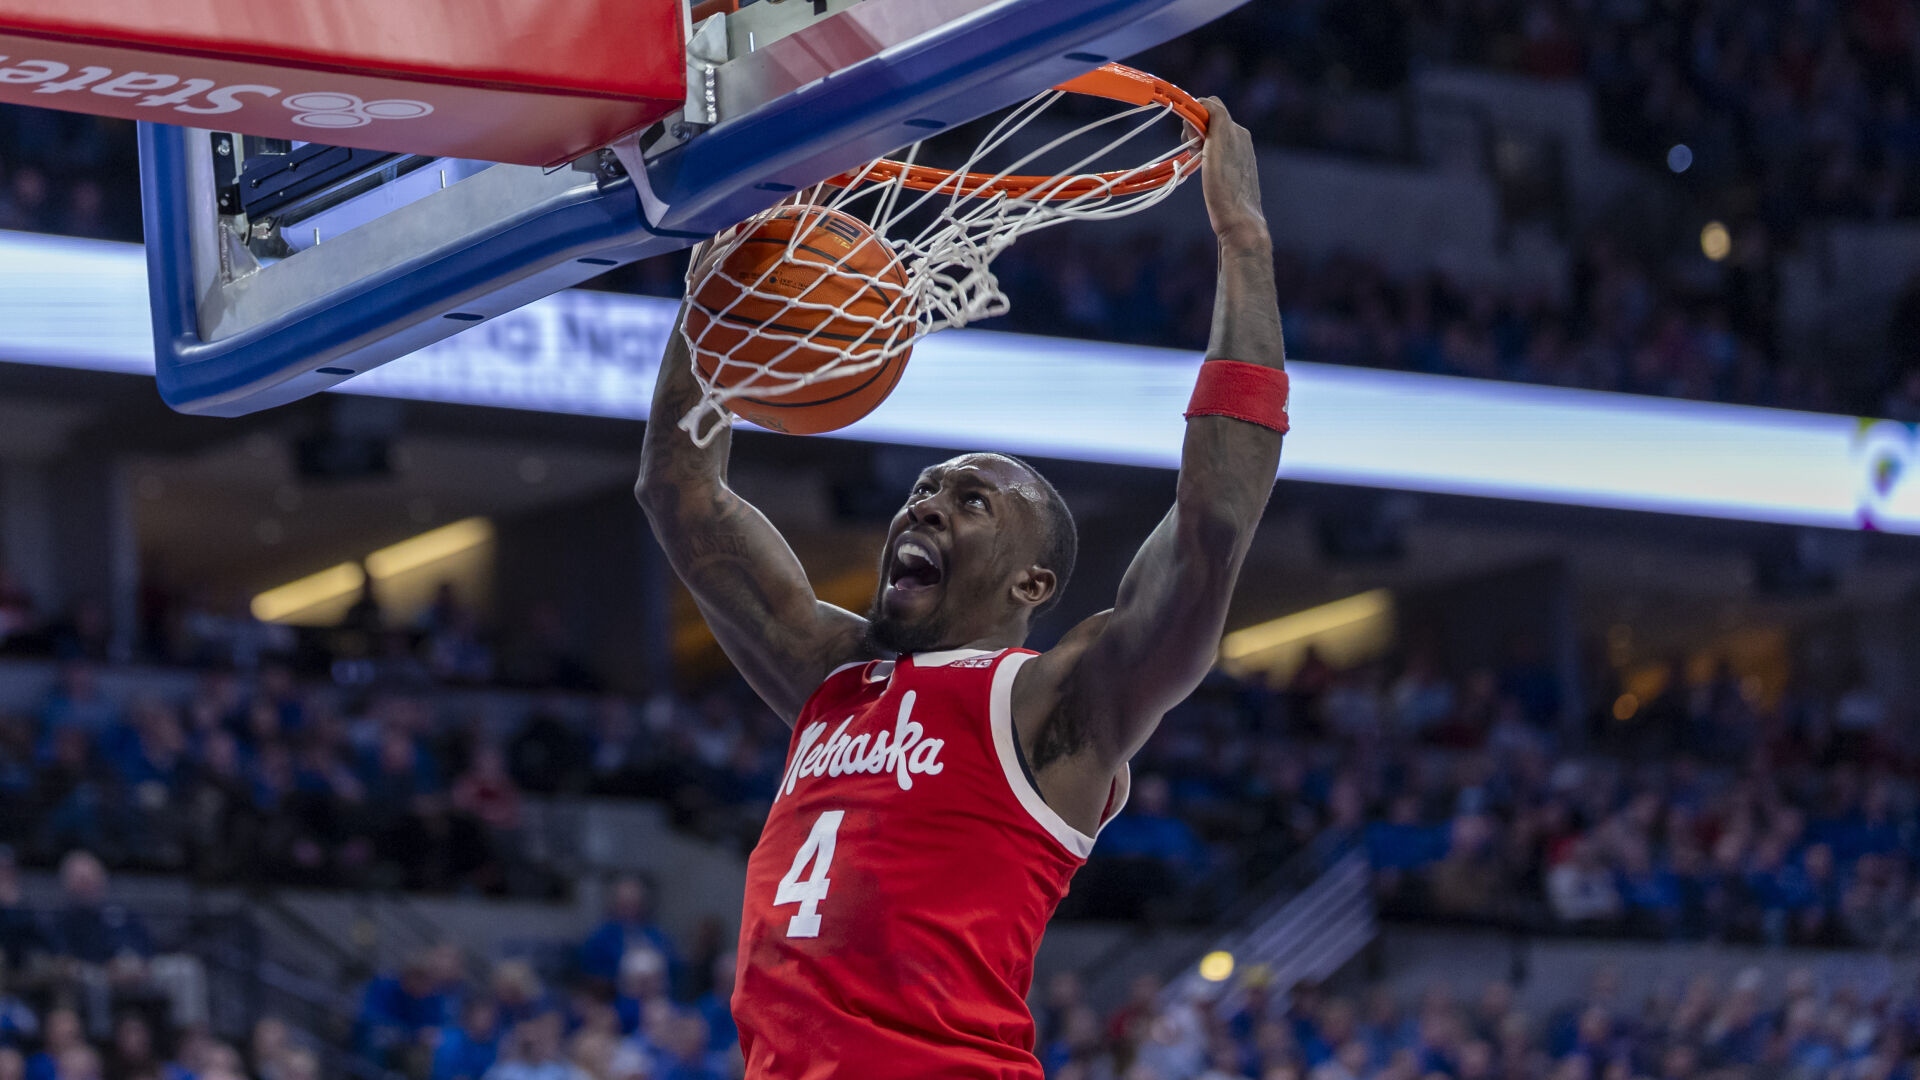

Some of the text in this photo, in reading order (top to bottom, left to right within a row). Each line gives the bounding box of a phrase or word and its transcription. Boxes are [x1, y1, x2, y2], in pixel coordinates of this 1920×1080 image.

[0, 59, 282, 115] State
[774, 690, 945, 803] Nebraska
[773, 810, 845, 938] 4
